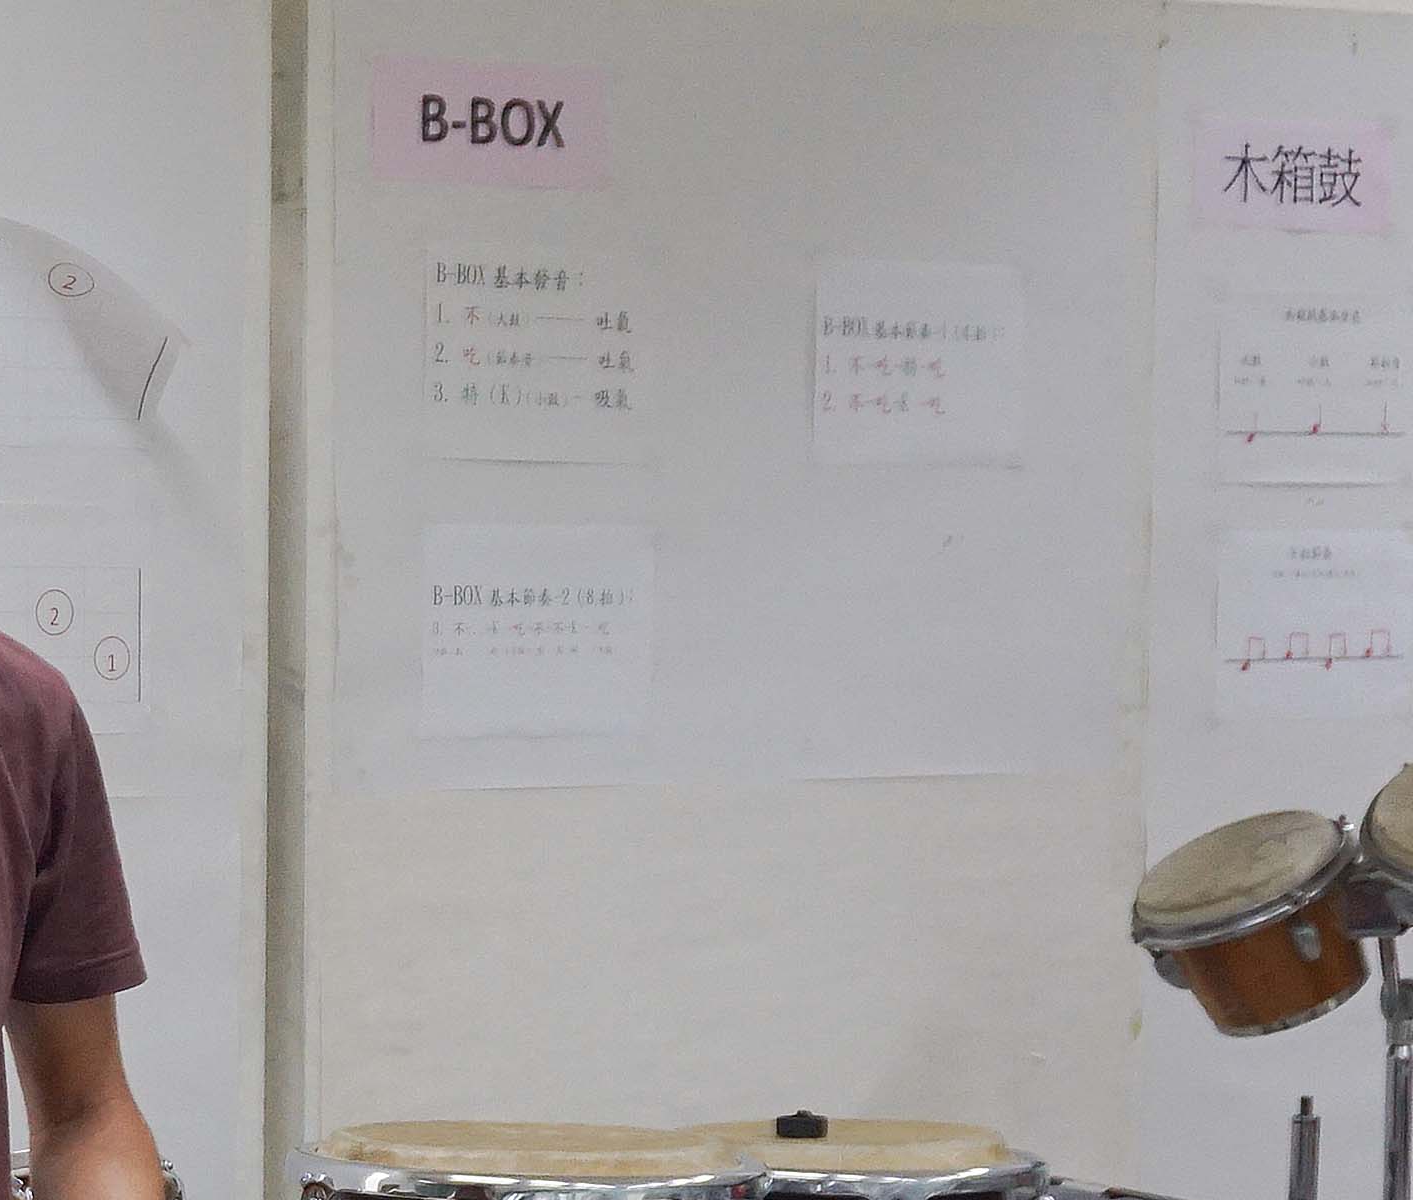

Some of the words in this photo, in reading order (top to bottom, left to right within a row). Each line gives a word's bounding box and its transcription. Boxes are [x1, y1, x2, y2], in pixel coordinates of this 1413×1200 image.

[422, 94, 564, 147] B-BOX
[1224, 143, 1362, 207] 木箱鼓
[436, 262, 485, 286] B-BOX
[433, 585, 483, 606] B-BOX
